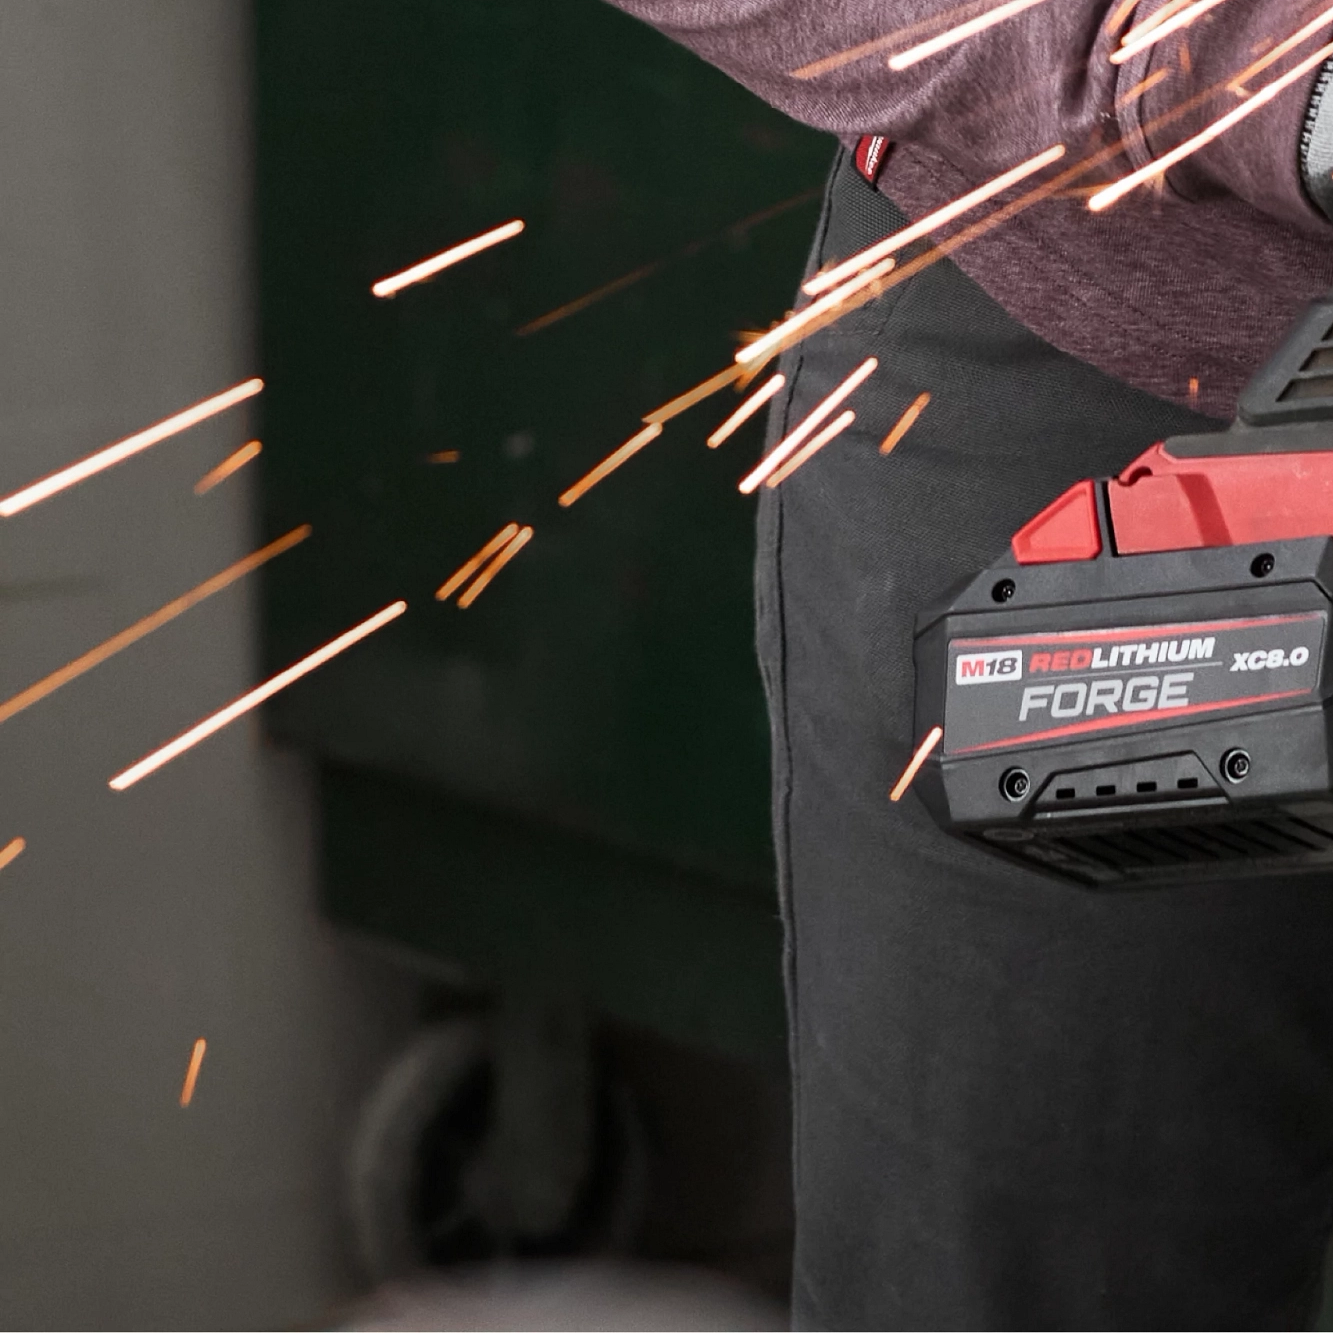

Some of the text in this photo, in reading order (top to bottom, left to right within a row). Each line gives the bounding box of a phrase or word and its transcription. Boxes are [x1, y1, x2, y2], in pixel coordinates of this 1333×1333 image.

[961, 656, 1018, 680] M18
[1230, 646, 1310, 673] XC8.0
[1018, 673, 1195, 722] FORGE
